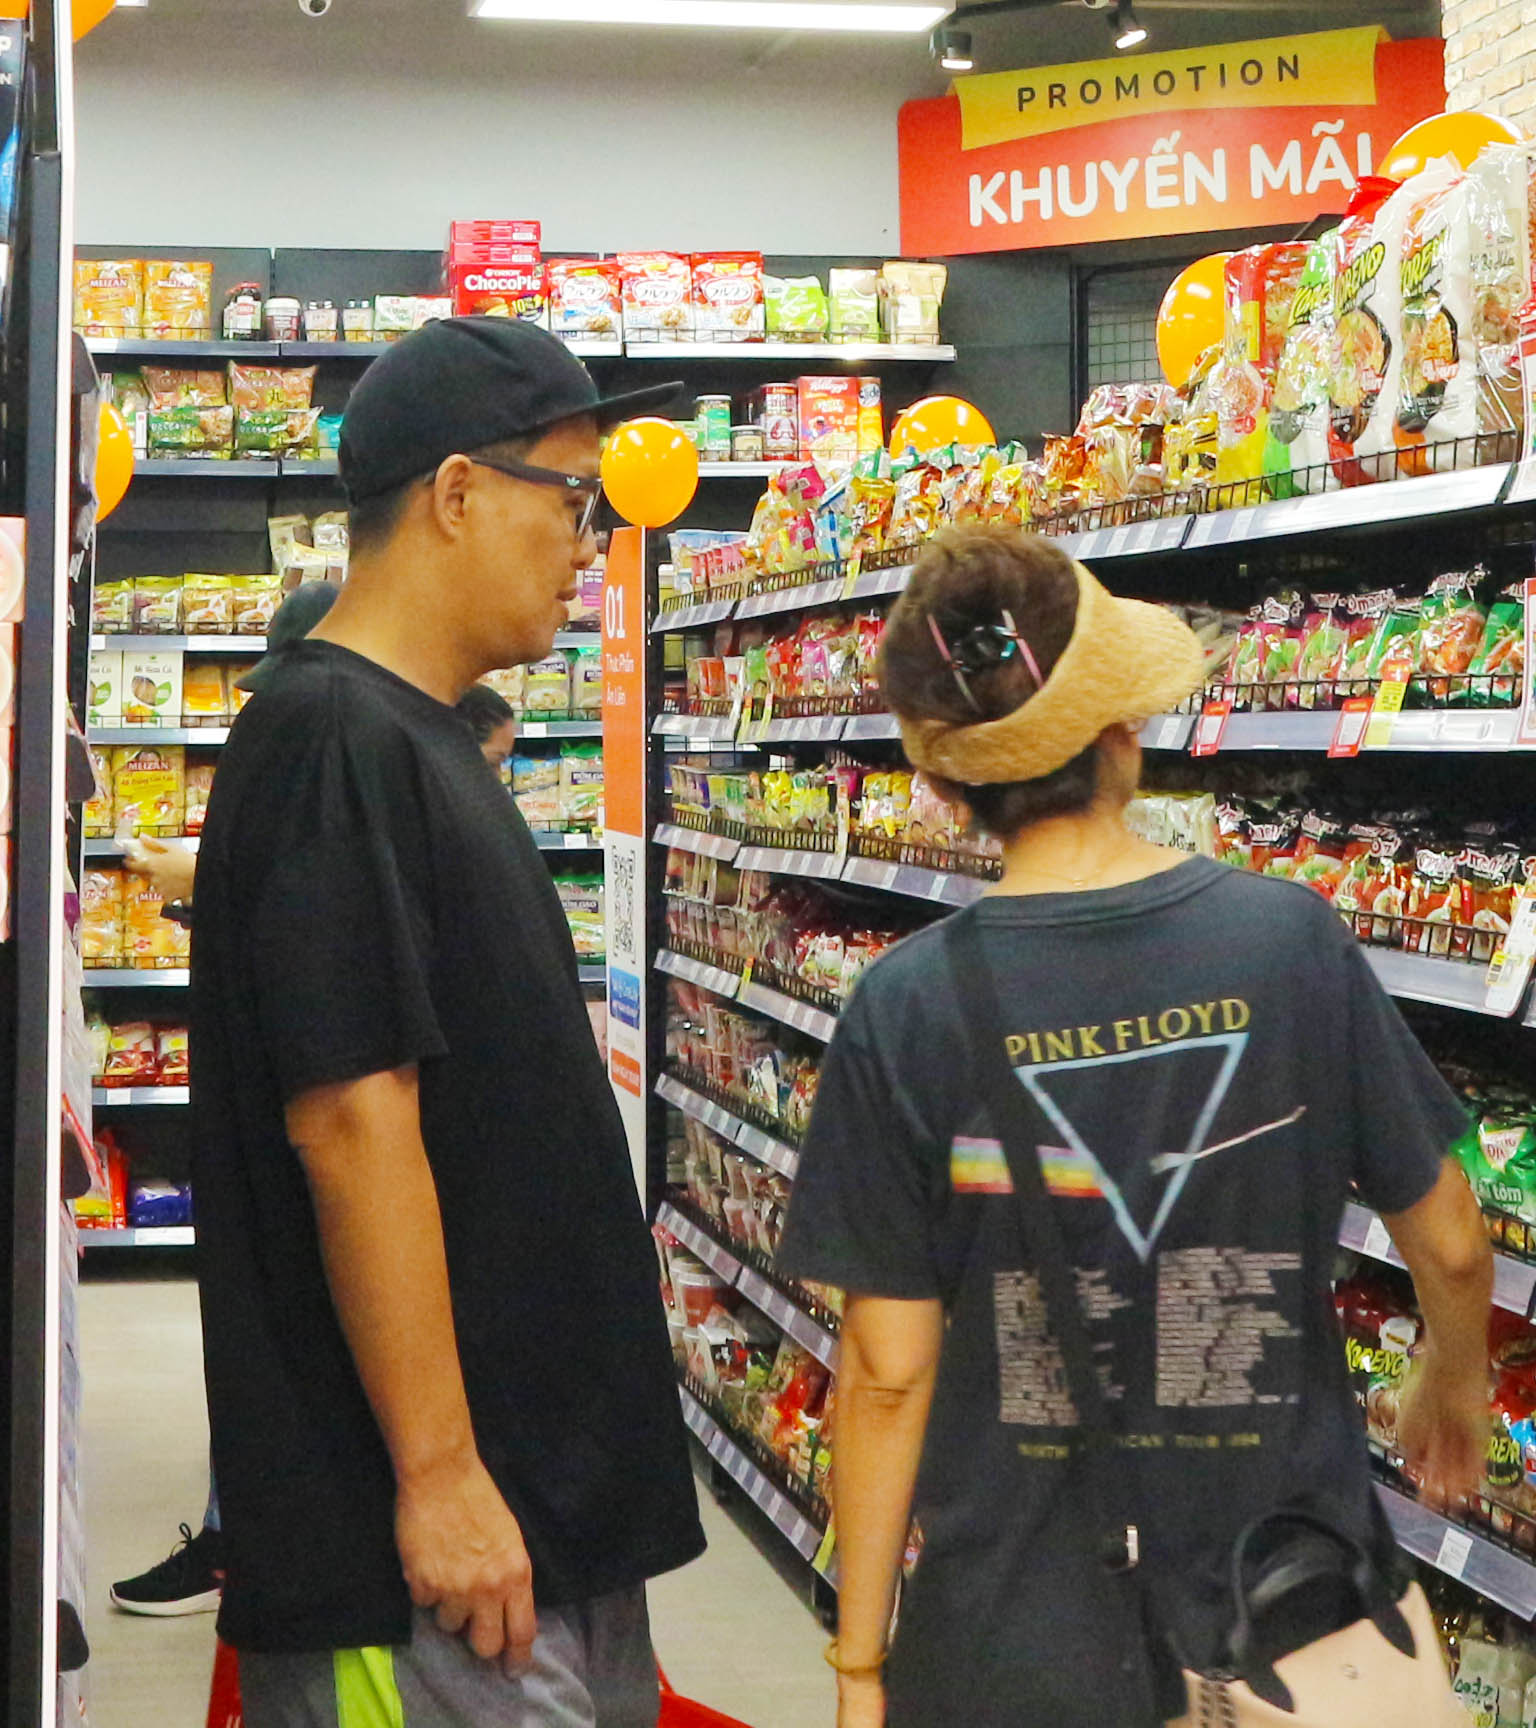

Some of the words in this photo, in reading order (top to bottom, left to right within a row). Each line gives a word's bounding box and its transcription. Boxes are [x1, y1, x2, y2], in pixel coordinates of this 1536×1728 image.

[1017, 54, 1300, 112] PROMOTION
[968, 130, 1228, 227] KHUYẾN
[1005, 1026, 1105, 1066] PINK
[1113, 998, 1251, 1051] FLOYD
